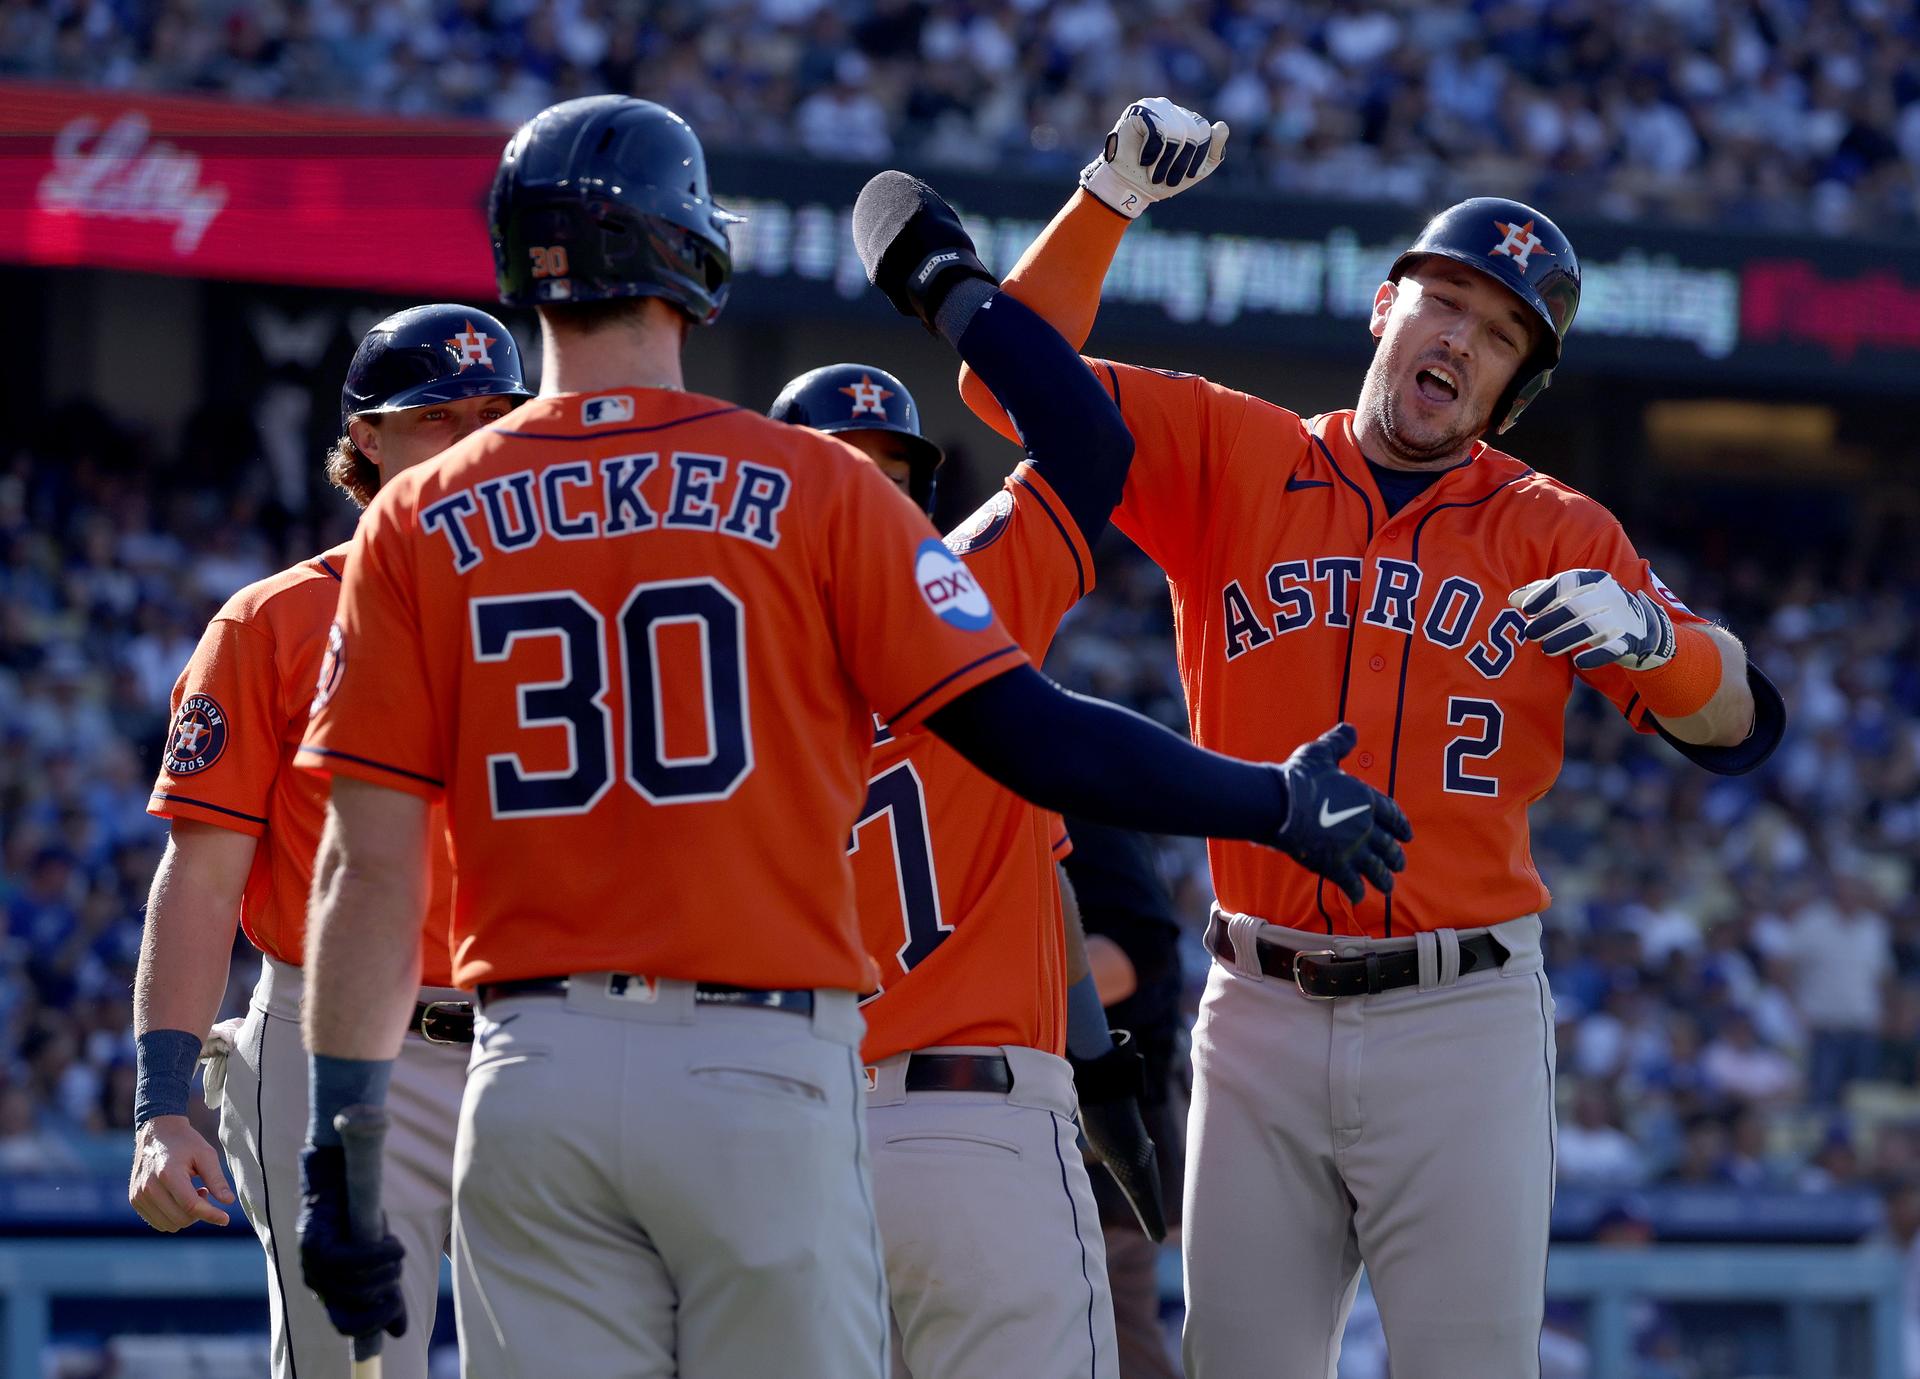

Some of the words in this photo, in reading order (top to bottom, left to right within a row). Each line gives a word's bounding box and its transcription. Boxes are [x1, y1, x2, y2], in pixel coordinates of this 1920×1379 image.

[528, 245, 569, 278] 30
[1494, 222, 1542, 268] H
[455, 332, 493, 365] H
[850, 383, 886, 413] H
[419, 452, 792, 575] TUCKER
[1222, 556, 1529, 680] ASTROS
[178, 699, 222, 727] HOUSTON
[469, 576, 755, 820] 30
[1443, 696, 1504, 797] 2
[846, 758, 956, 1001] 7
